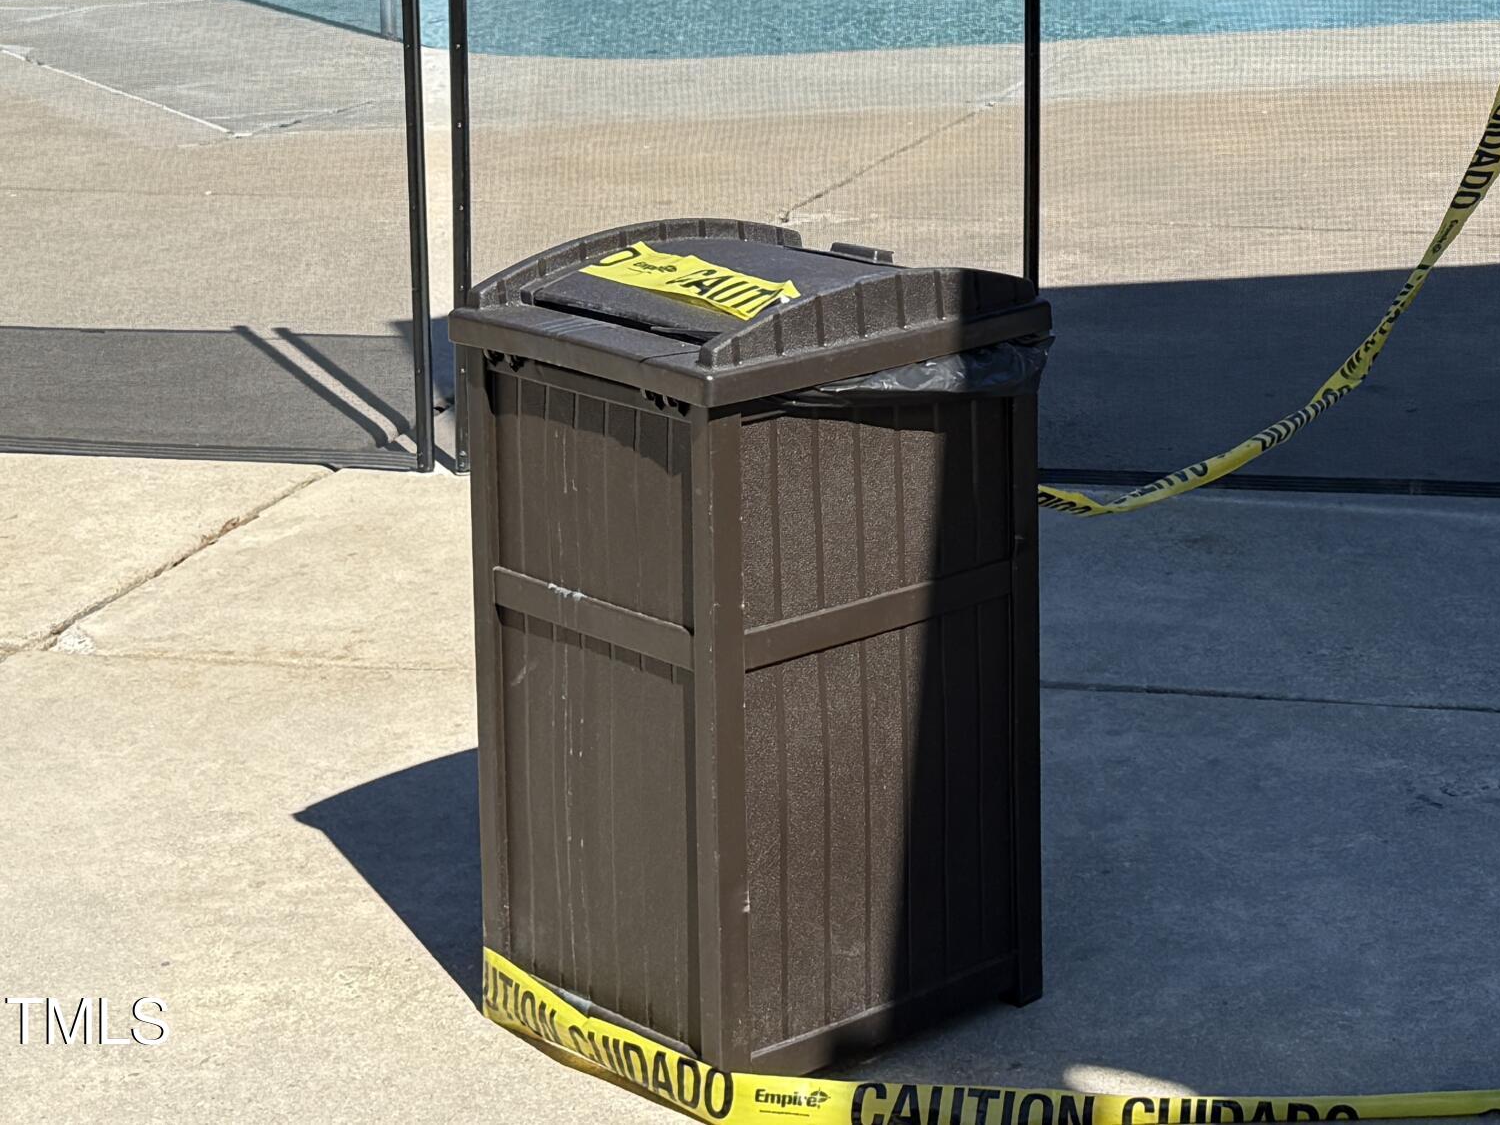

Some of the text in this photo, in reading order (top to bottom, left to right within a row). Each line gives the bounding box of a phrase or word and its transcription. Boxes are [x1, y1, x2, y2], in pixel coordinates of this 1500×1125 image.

[664, 268, 784, 314] CAUT
[484, 962, 562, 1045] UTION
[568, 1026, 734, 1119] CUIDADO
[755, 1088, 819, 1108] Empire
[851, 1083, 1095, 1125] CAUTION
